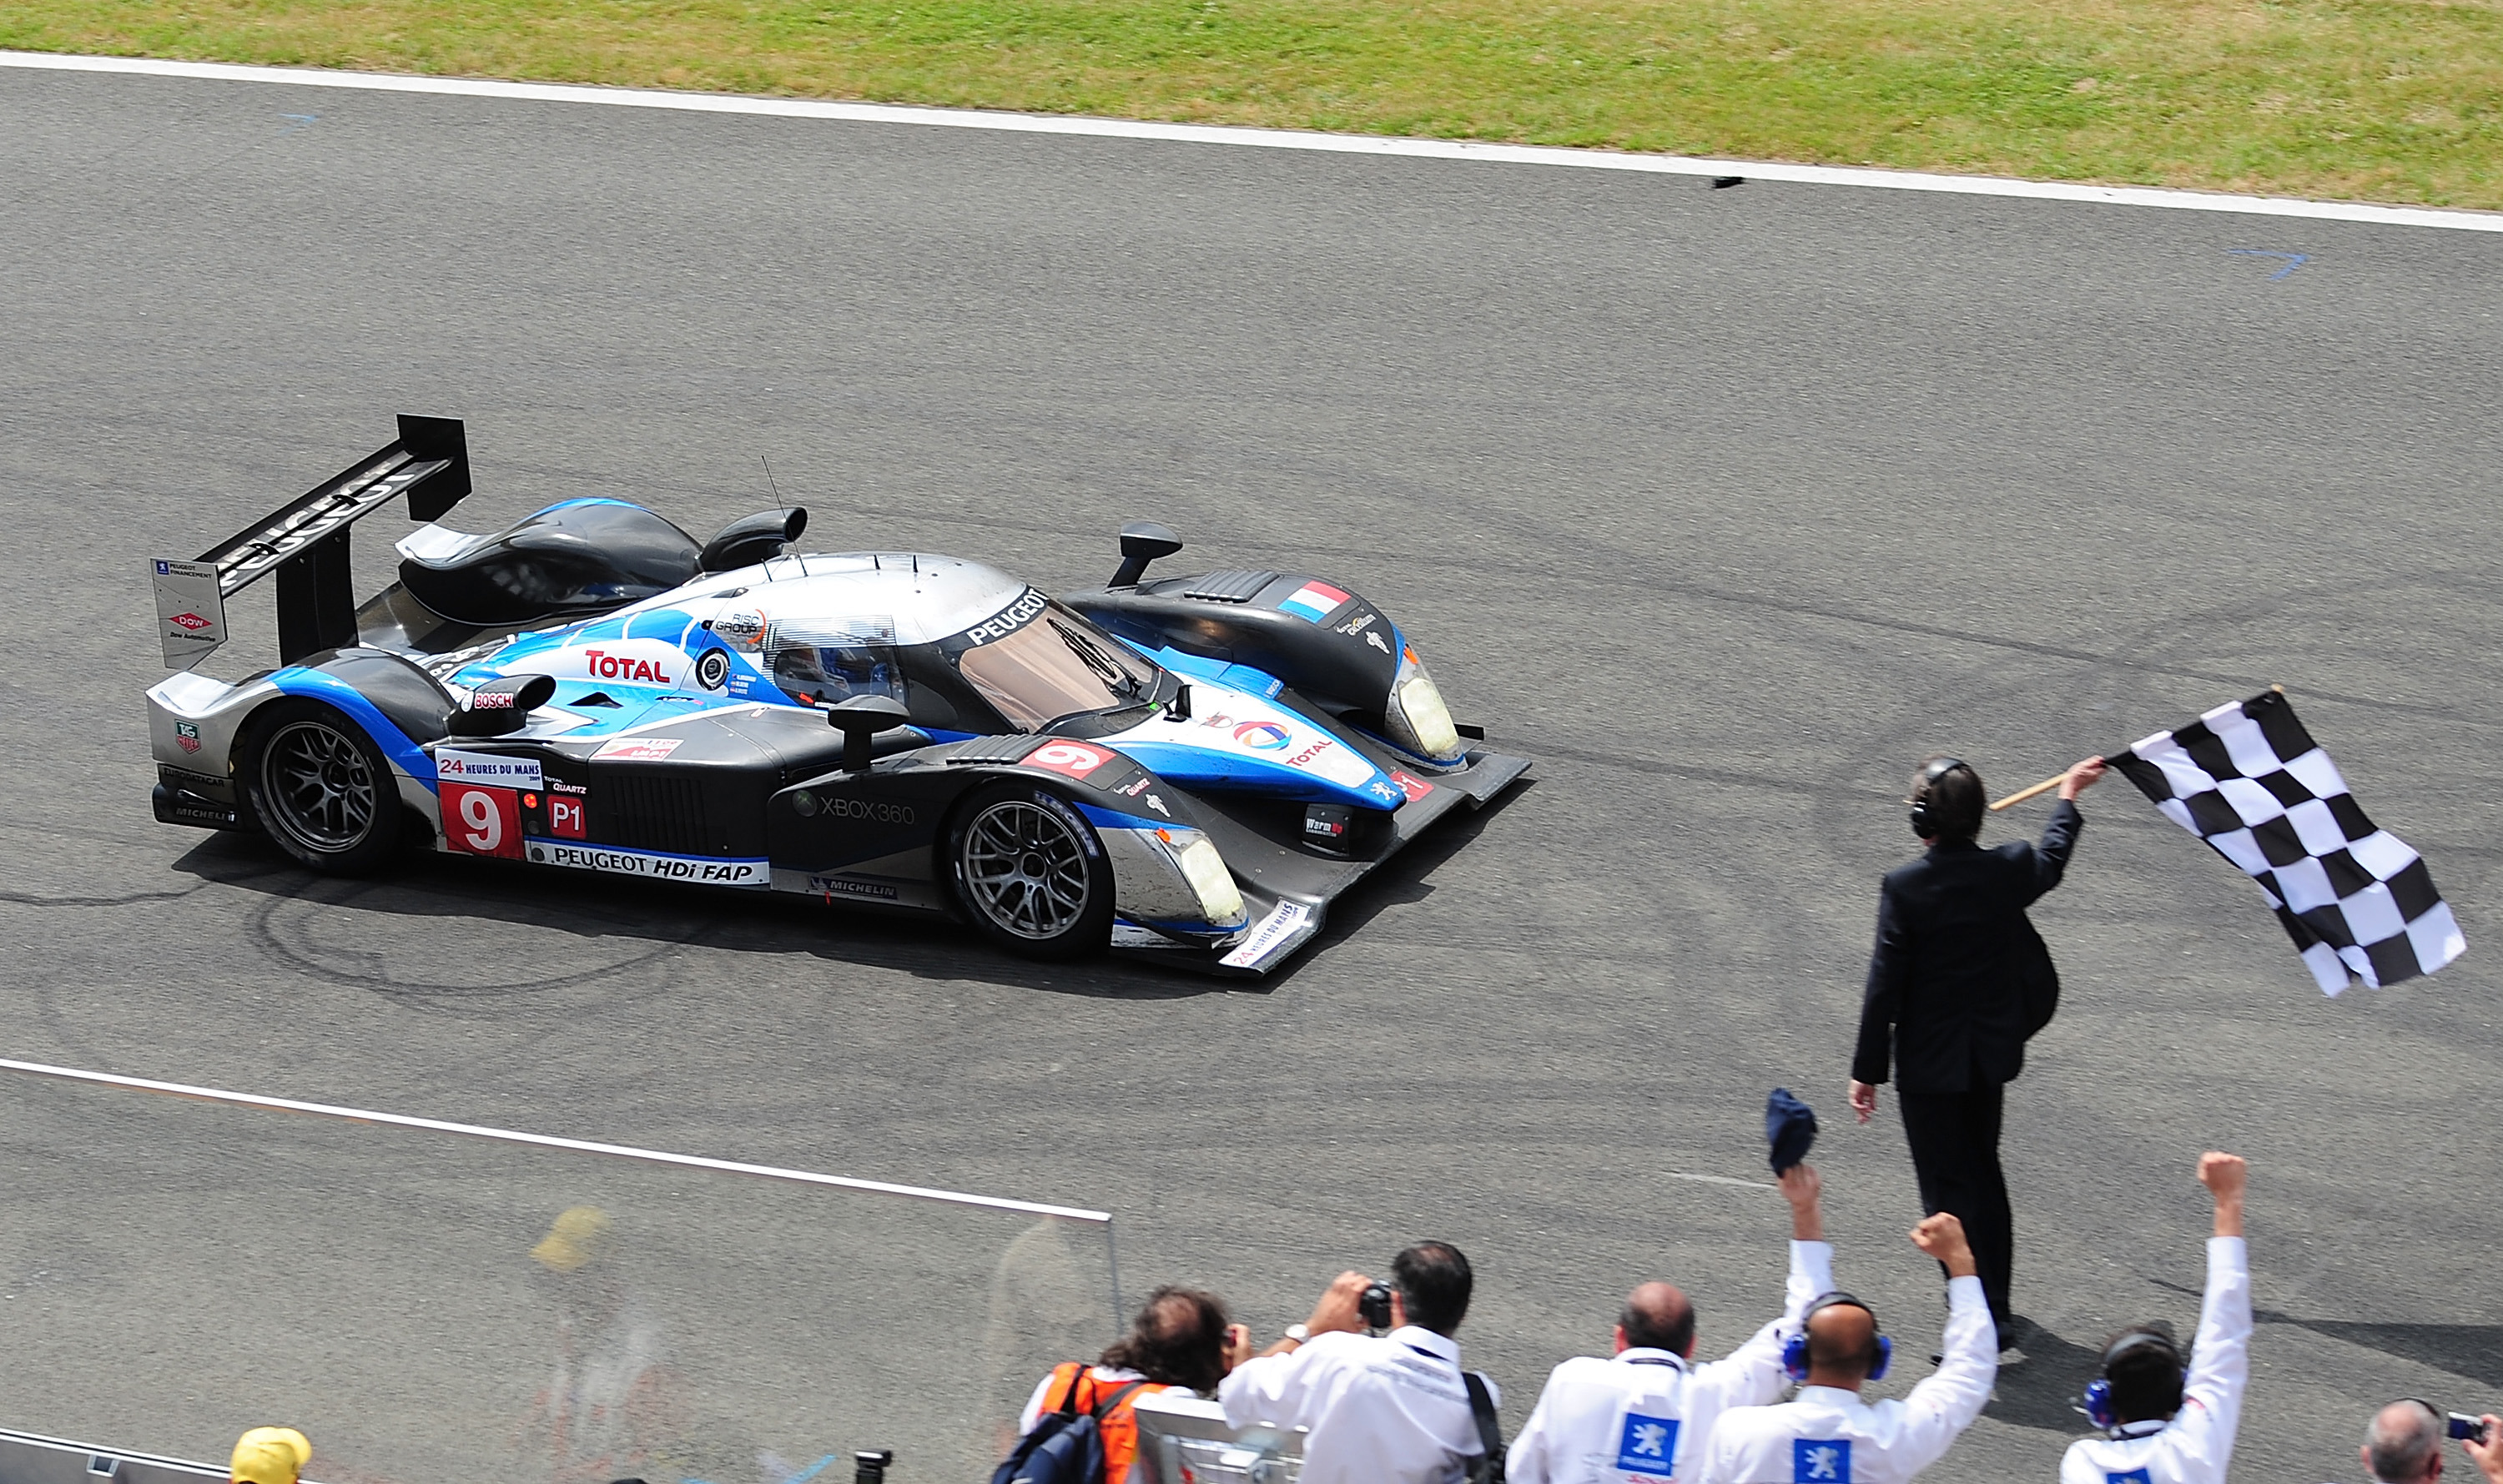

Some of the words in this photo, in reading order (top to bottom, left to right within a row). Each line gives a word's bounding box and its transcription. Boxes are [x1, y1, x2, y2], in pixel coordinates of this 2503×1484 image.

[171, 570, 212, 579] FINANCEMENT
[179, 616, 204, 626] DOW
[733, 614, 759, 626] RISC
[966, 588, 1050, 646] PEUGEOT
[716, 621, 757, 633] GROUP
[586, 650, 670, 683] TOTAL
[475, 693, 514, 708] BOSCH
[179, 723, 196, 737] TAG
[1035, 745, 1100, 770] 9
[1286, 741, 1332, 767] TOTAL
[440, 759, 464, 774] 24
[466, 764, 497, 775] HEURES
[500, 765, 512, 775] DU
[515, 765, 540, 775] MANS
[553, 783, 587, 794] QUARTZ
[460, 791, 501, 851] 9
[553, 802, 580, 831] P1
[554, 848, 647, 873] PEUGEOT
[653, 860, 698, 878] HDi
[702, 864, 753, 882] FAP
[830, 881, 895, 896] MICHELIN
[1233, 952, 1254, 964] 24
[1267, 924, 1279, 933] DU
[1274, 903, 1293, 926] MANS
